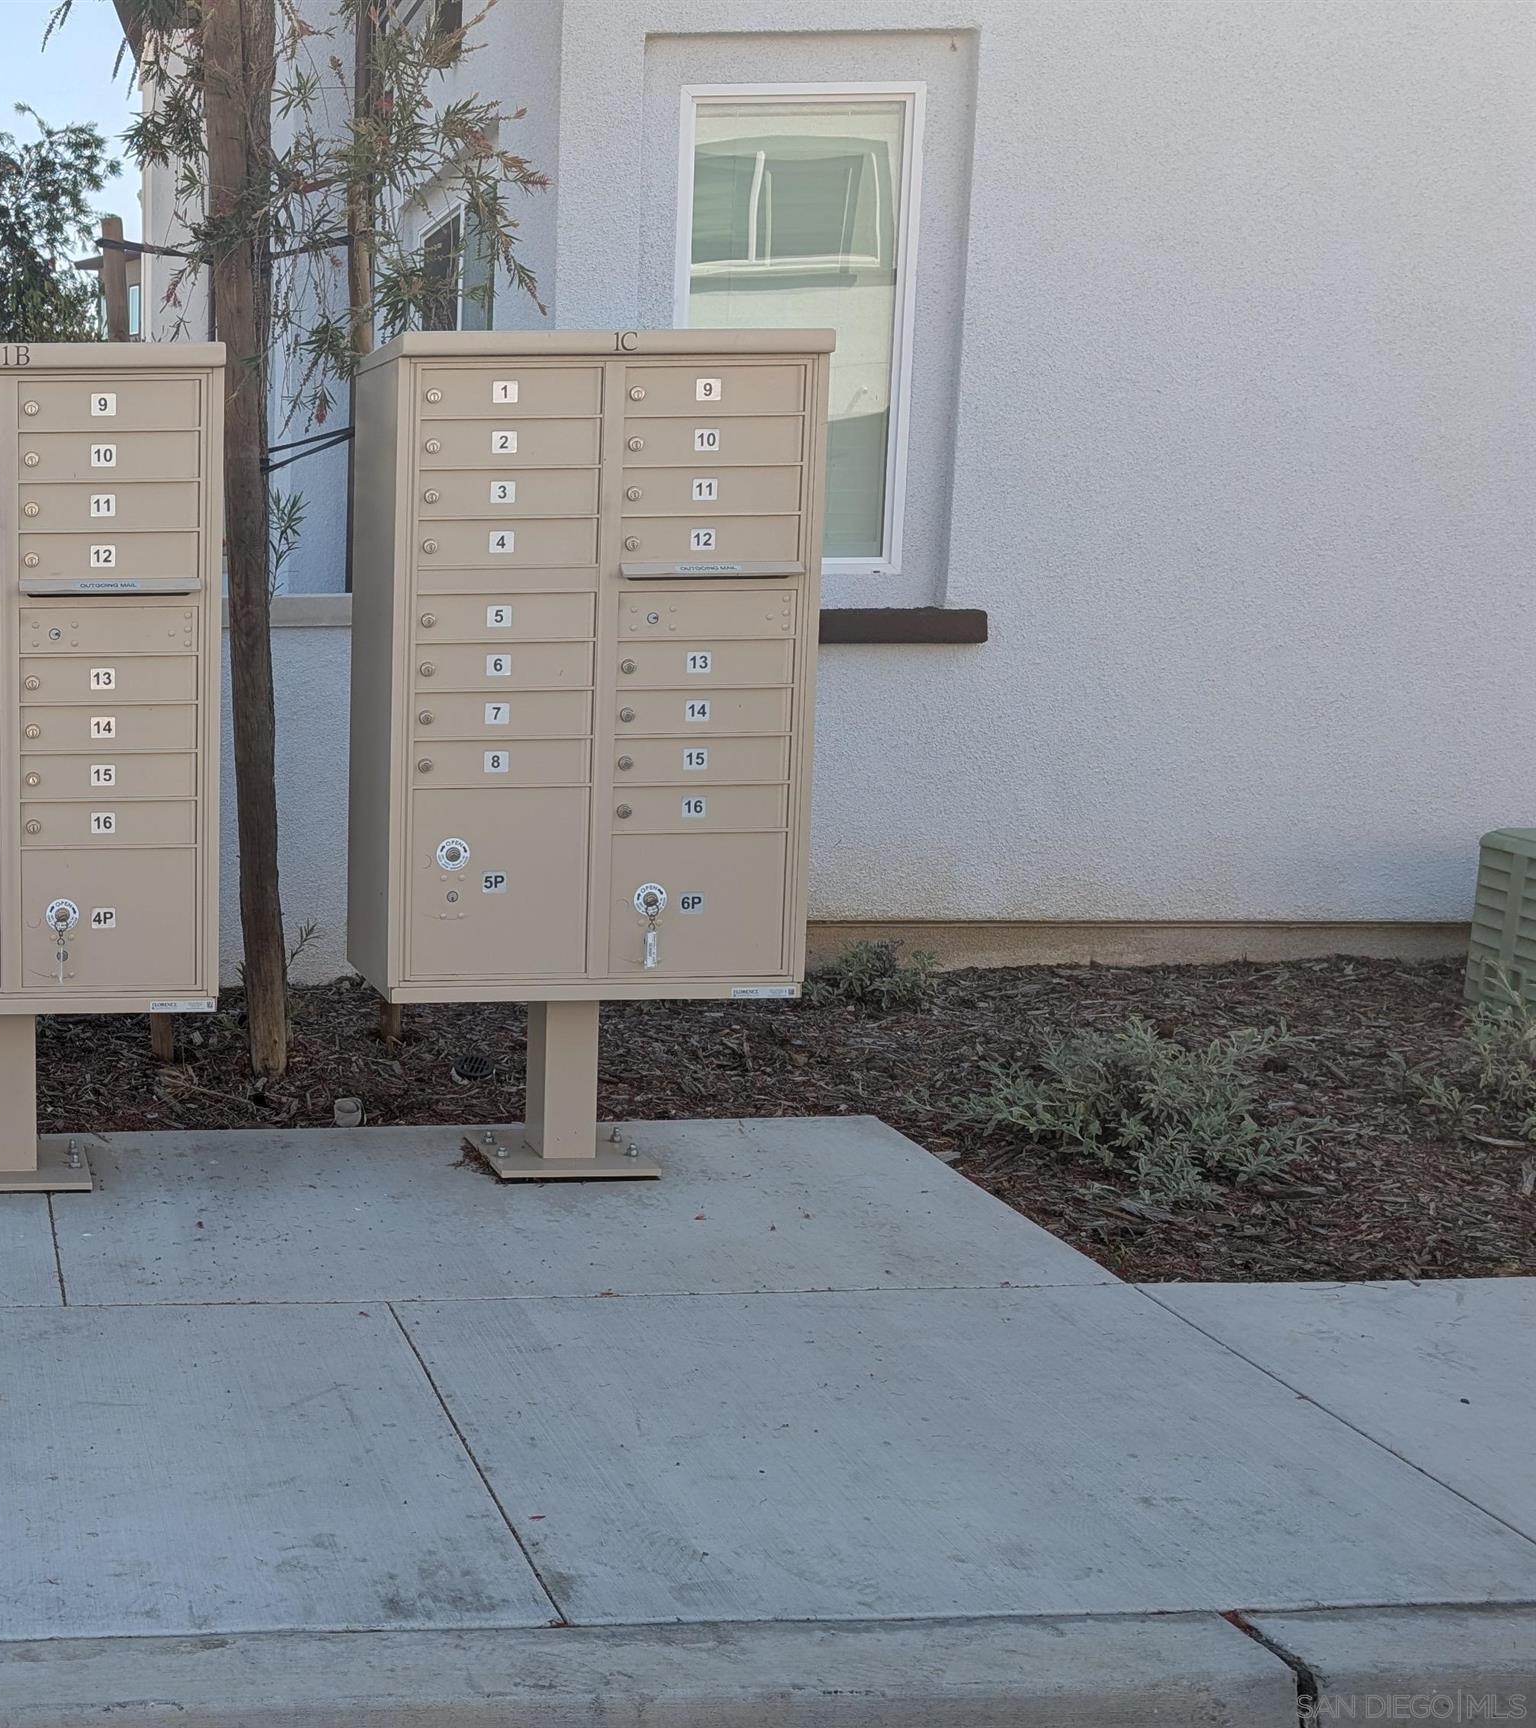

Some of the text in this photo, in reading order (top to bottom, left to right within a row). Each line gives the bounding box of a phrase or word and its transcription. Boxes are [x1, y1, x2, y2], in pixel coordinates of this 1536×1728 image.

[613, 331, 639, 352] 1C
[1, 345, 31, 367] 1B
[500, 384, 508, 399] 1
[703, 382, 713, 397] 9
[97, 397, 108, 412] 9
[499, 435, 509, 450] 2
[697, 432, 717, 447] 10
[94, 448, 113, 463] 10
[497, 485, 507, 500] 3
[695, 482, 713, 497] 11
[93, 498, 111, 513] 11
[495, 535, 506, 549] 4
[693, 532, 713, 547] 12
[93, 548, 112, 563] 12
[494, 609, 504, 624] 5
[493, 658, 503, 672] 6
[689, 655, 708, 670] 13
[93, 671, 112, 686] 13
[492, 706, 502, 721] 7
[688, 703, 707, 718] 14
[93, 720, 113, 735] 14
[491, 754, 501, 769] 8
[686, 752, 705, 766] 15
[93, 768, 113, 782] 15
[684, 799, 703, 814] 16
[93, 815, 113, 830] 16
[484, 875, 505, 889] 5P
[681, 896, 702, 910] 6P
[92, 911, 114, 925] 4P
